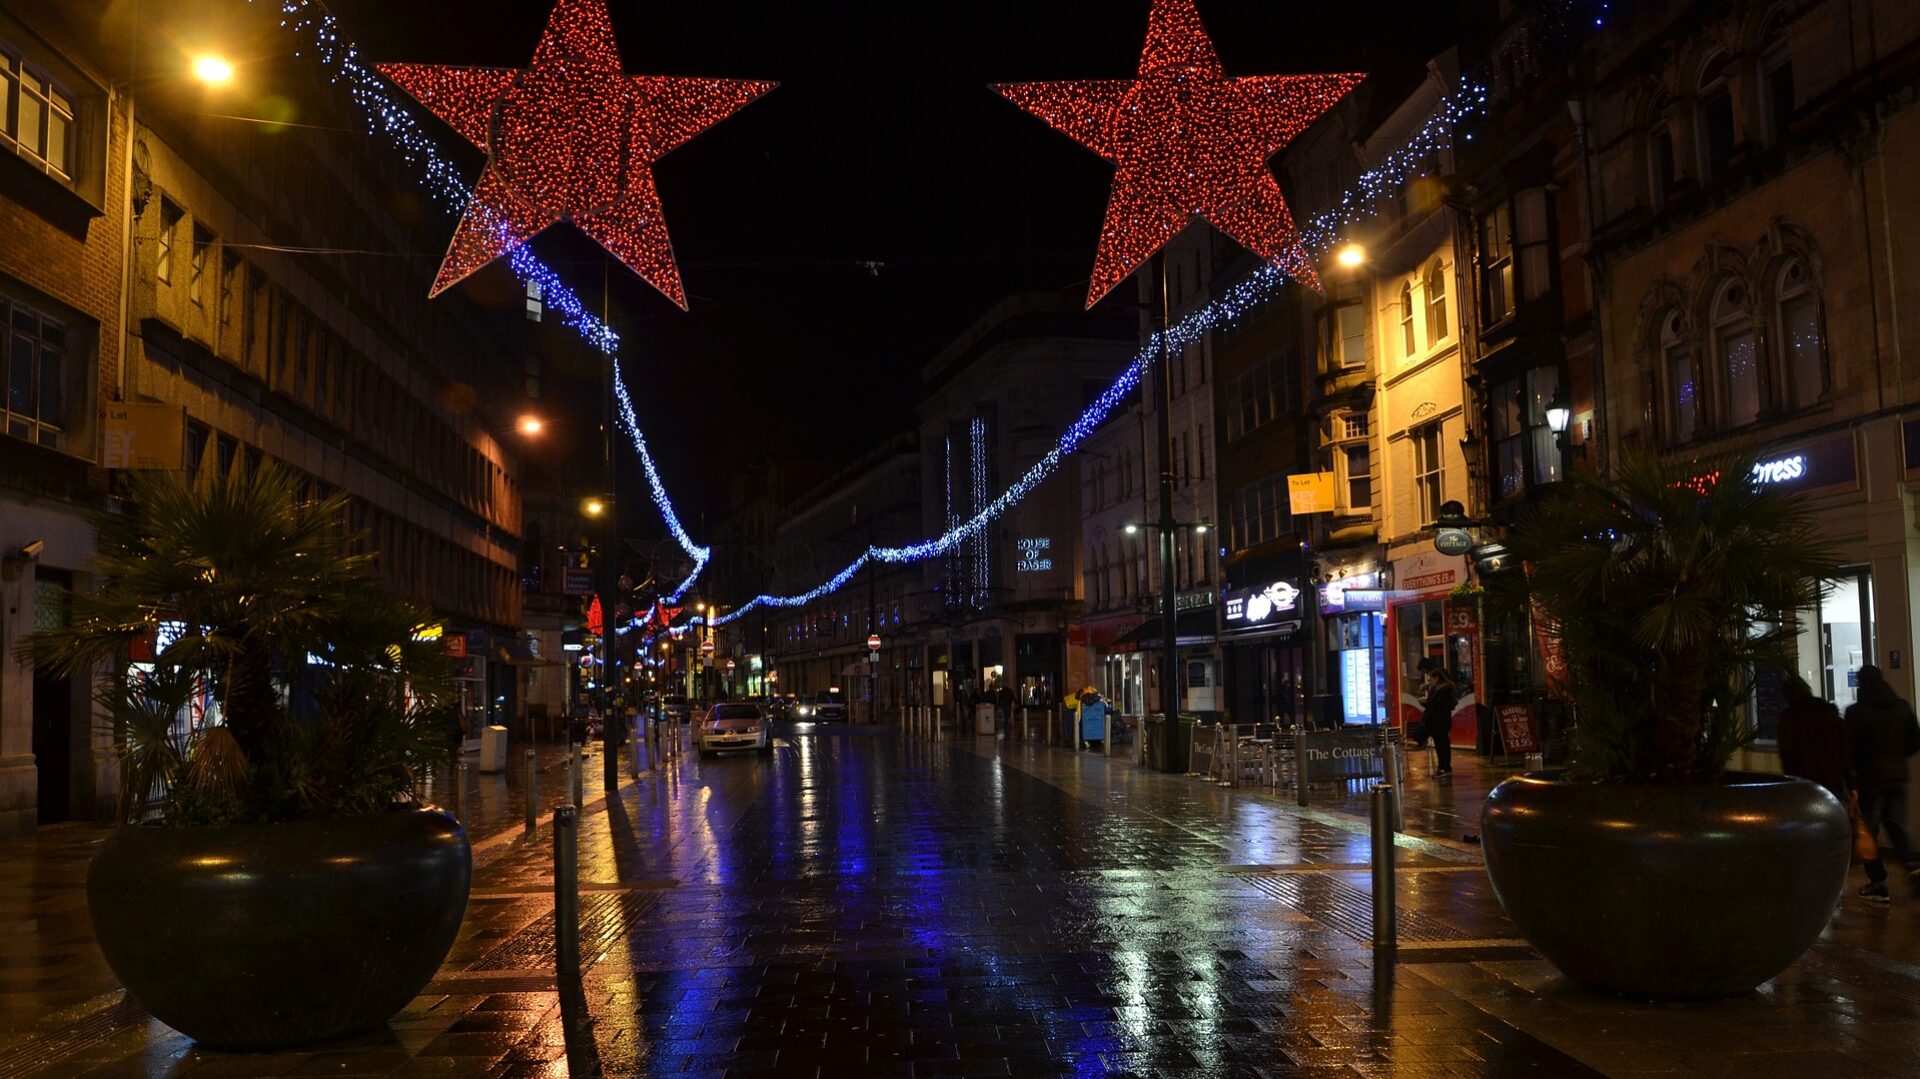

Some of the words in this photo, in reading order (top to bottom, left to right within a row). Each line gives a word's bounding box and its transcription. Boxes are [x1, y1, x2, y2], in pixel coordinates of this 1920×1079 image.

[110, 410, 128, 420] Let
[1016, 538, 1051, 550] HOUSE
[1440, 540, 1467, 549] COTTAGE
[1025, 549, 1040, 560] OF
[1016, 559, 1052, 571] FRASER
[1403, 572, 1441, 590] EVERYTHING'S
[1306, 748, 1329, 761] The
[1332, 746, 1376, 759] Cottage
